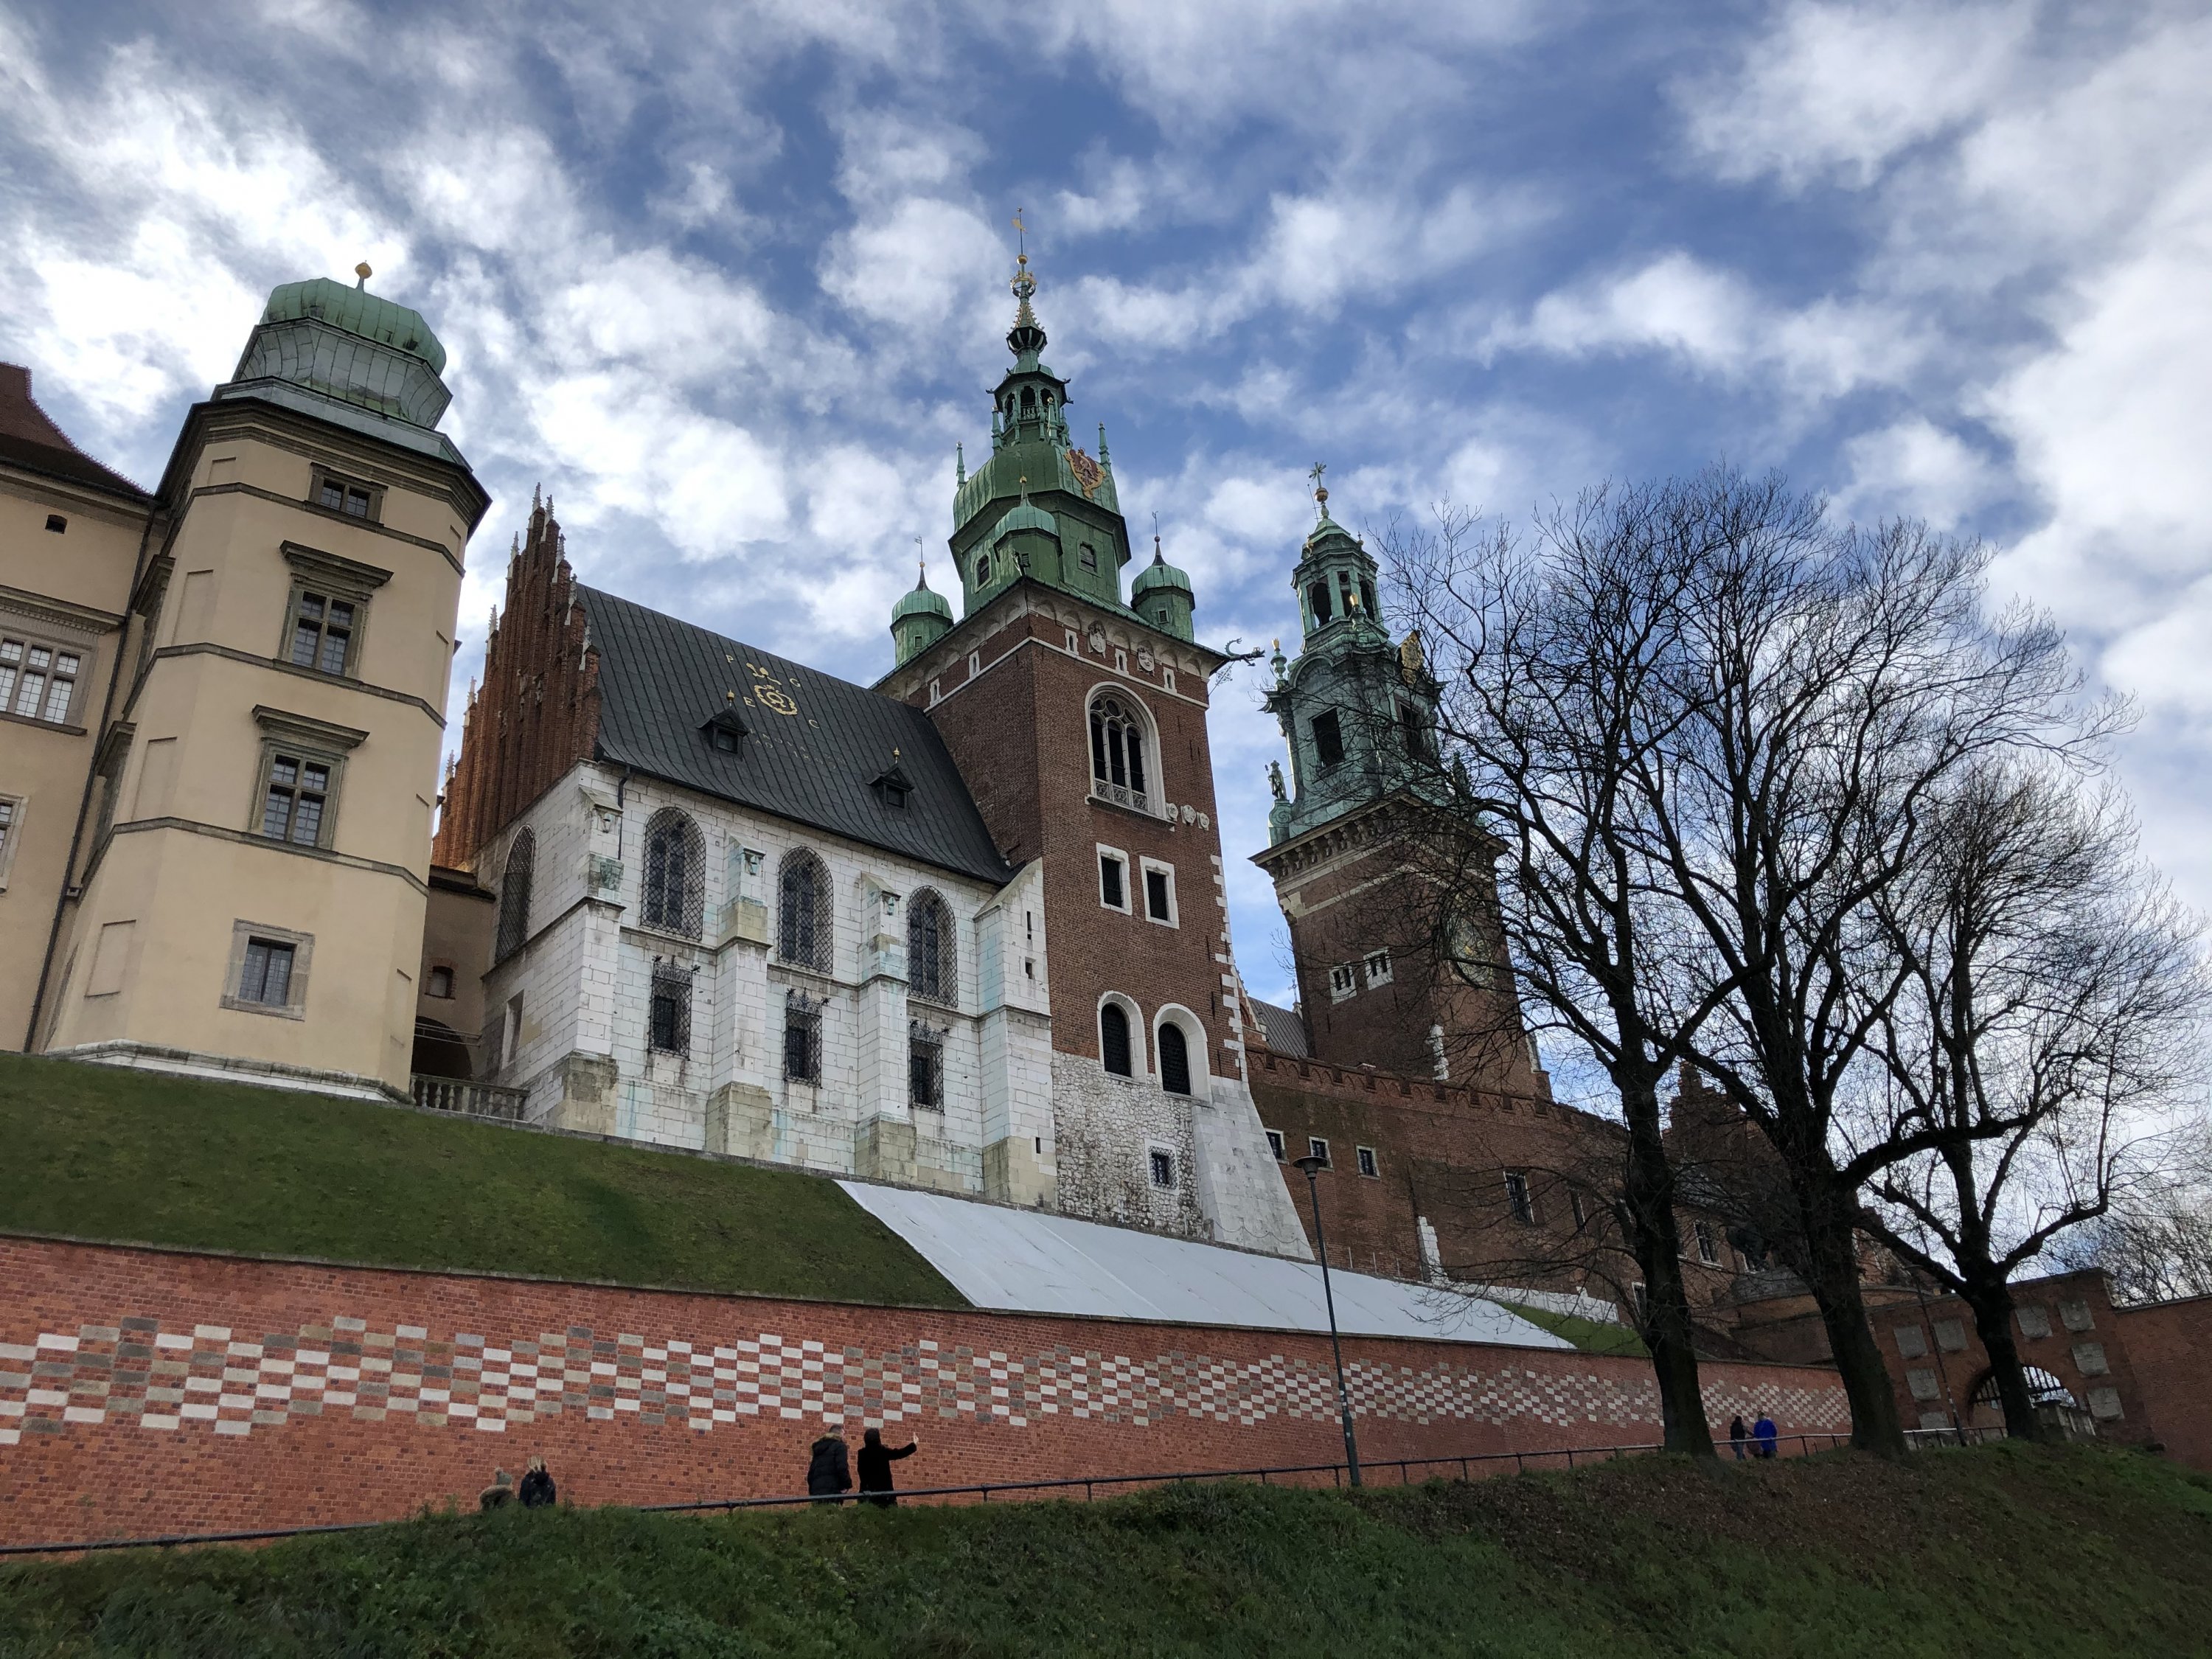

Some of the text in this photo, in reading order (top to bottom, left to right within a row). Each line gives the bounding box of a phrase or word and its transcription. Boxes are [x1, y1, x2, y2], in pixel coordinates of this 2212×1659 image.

[726, 654, 801, 687] P G
[742, 696, 820, 729] E C
